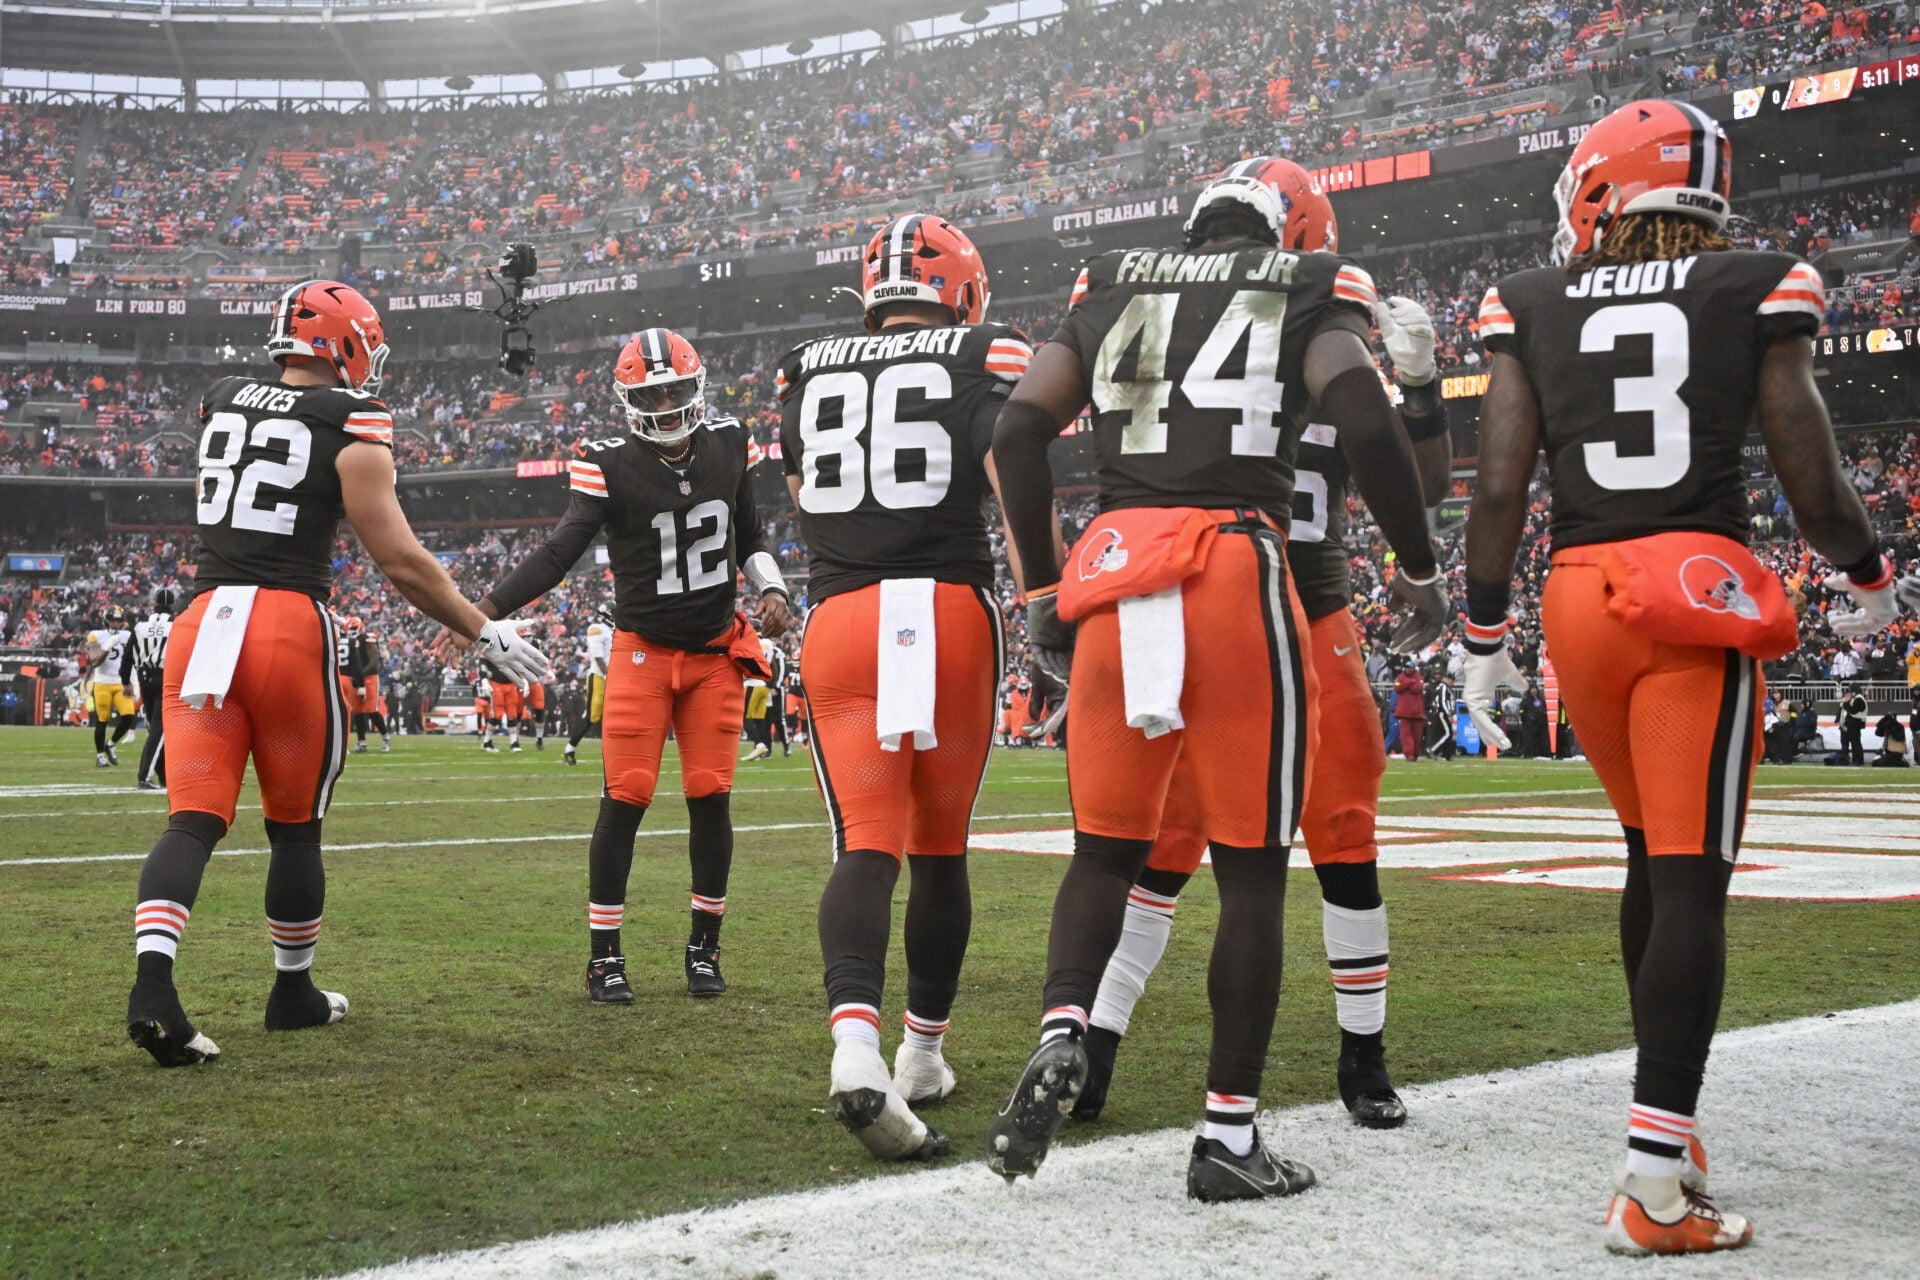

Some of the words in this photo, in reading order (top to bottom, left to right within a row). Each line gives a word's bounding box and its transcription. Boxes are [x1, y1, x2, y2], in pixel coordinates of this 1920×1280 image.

[1862, 68, 1890, 88] 5:11
[1518, 129, 1563, 154] PAUL
[1053, 211, 1092, 232] OTTO
[1095, 201, 1157, 225] GRAHAM
[1161, 196, 1179, 216] 14
[816, 245, 859, 266] DANTE
[1115, 251, 1239, 284] FANNIN
[1246, 251, 1300, 284] JR
[700, 261, 731, 282] 5:11
[1565, 256, 1698, 298] JEUDY
[388, 296, 416, 311] BILL
[465, 291, 483, 307] 60
[521, 282, 567, 301] MARION
[621, 274, 638, 290] 36
[873, 286, 918, 299] CLEVELAND
[95, 299, 123, 313] LEN
[129, 300, 163, 314] FORD
[168, 300, 186, 315] 80
[220, 300, 250, 315] CLAY
[800, 328, 971, 374] WHITEHEART
[1092, 289, 1288, 457] 44
[231, 383, 304, 413] BATES
[1579, 302, 1691, 490] 3
[798, 362, 952, 514] 86
[197, 412, 312, 536] 82
[651, 499, 729, 595] 12
[148, 626, 165, 637] 56
